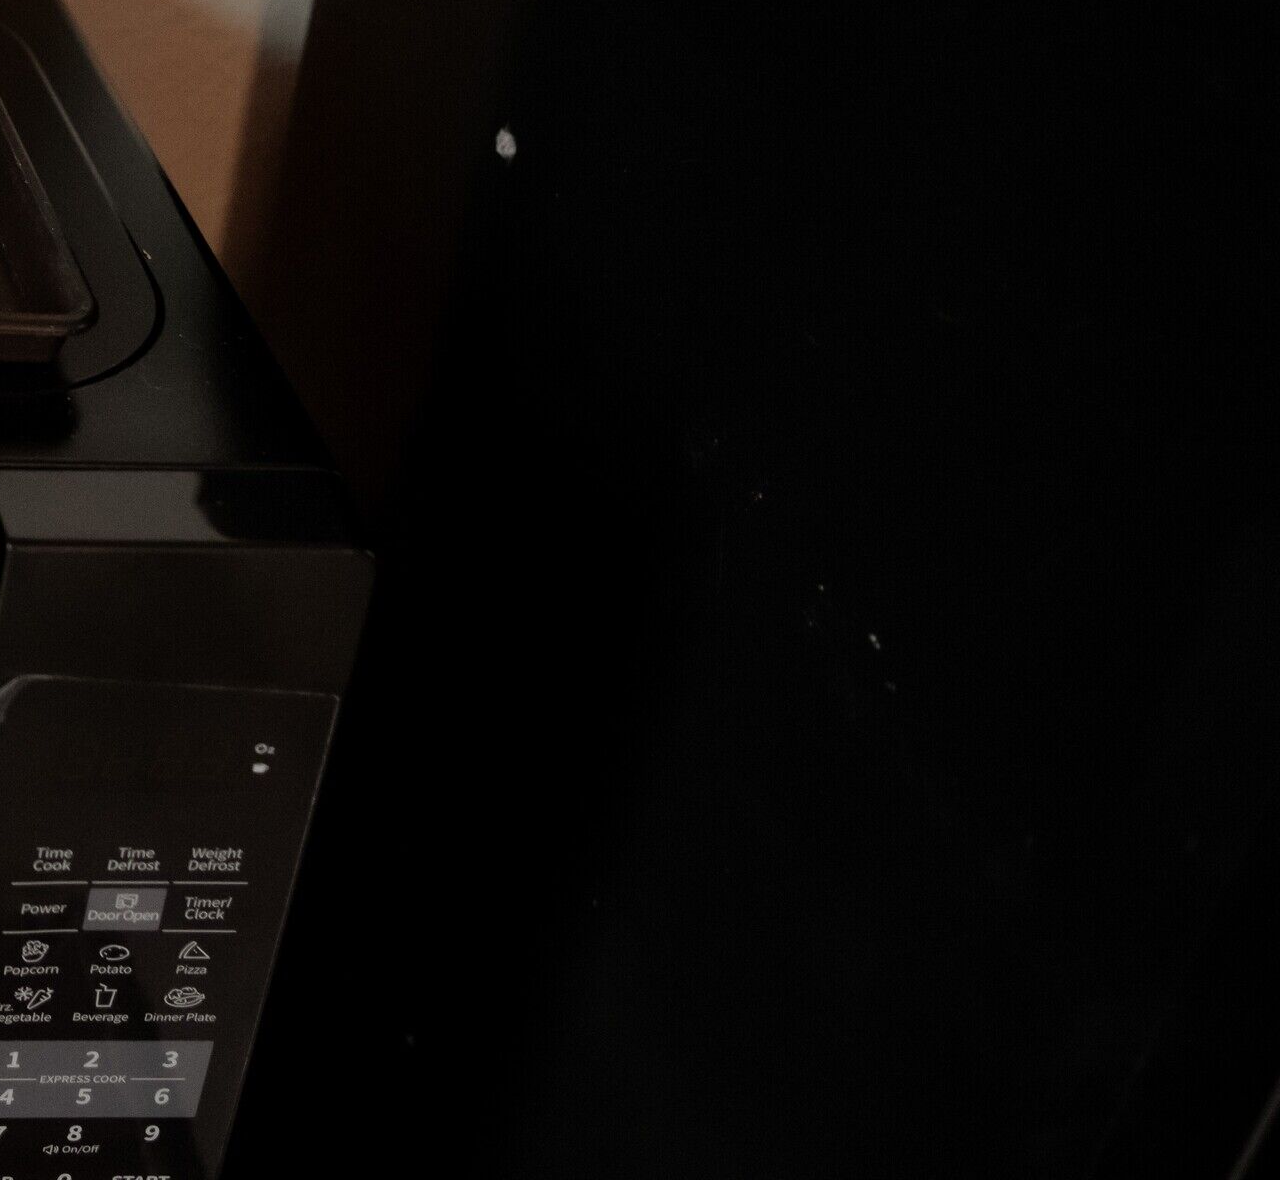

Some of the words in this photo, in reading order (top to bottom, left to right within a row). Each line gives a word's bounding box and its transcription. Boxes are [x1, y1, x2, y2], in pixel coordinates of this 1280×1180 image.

[36, 847, 74, 859] Time
[118, 847, 156, 859] Time
[191, 847, 243, 862] Weight
[33, 859, 71, 872] Cook
[107, 859, 160, 872] Defrost
[188, 859, 241, 872] Defrost
[185, 896, 233, 909] Timer/
[20, 903, 67, 916] Power
[184, 908, 225, 921] Clock
[87, 910, 122, 922] Door
[122, 910, 160, 923] Open
[3, 964, 60, 978] Popcorn
[89, 964, 132, 975] Potato
[175, 964, 208, 975] Pizza
[72, 1012, 129, 1025] Beverage
[143, 1012, 183, 1023] Dinner
[185, 1012, 217, 1023] Plate
[6, 1051, 21, 1068] 1
[83, 1051, 100, 1068] 2
[162, 1051, 179, 1068] 3
[39, 1074, 91, 1084] EXPRESS
[93, 1074, 127, 1084] COOK
[76, 1089, 92, 1106] 5
[154, 1089, 171, 1106] 6
[66, 1125, 83, 1143] 8
[143, 1125, 161, 1143] 9
[61, 1144, 101, 1155] On/Off
